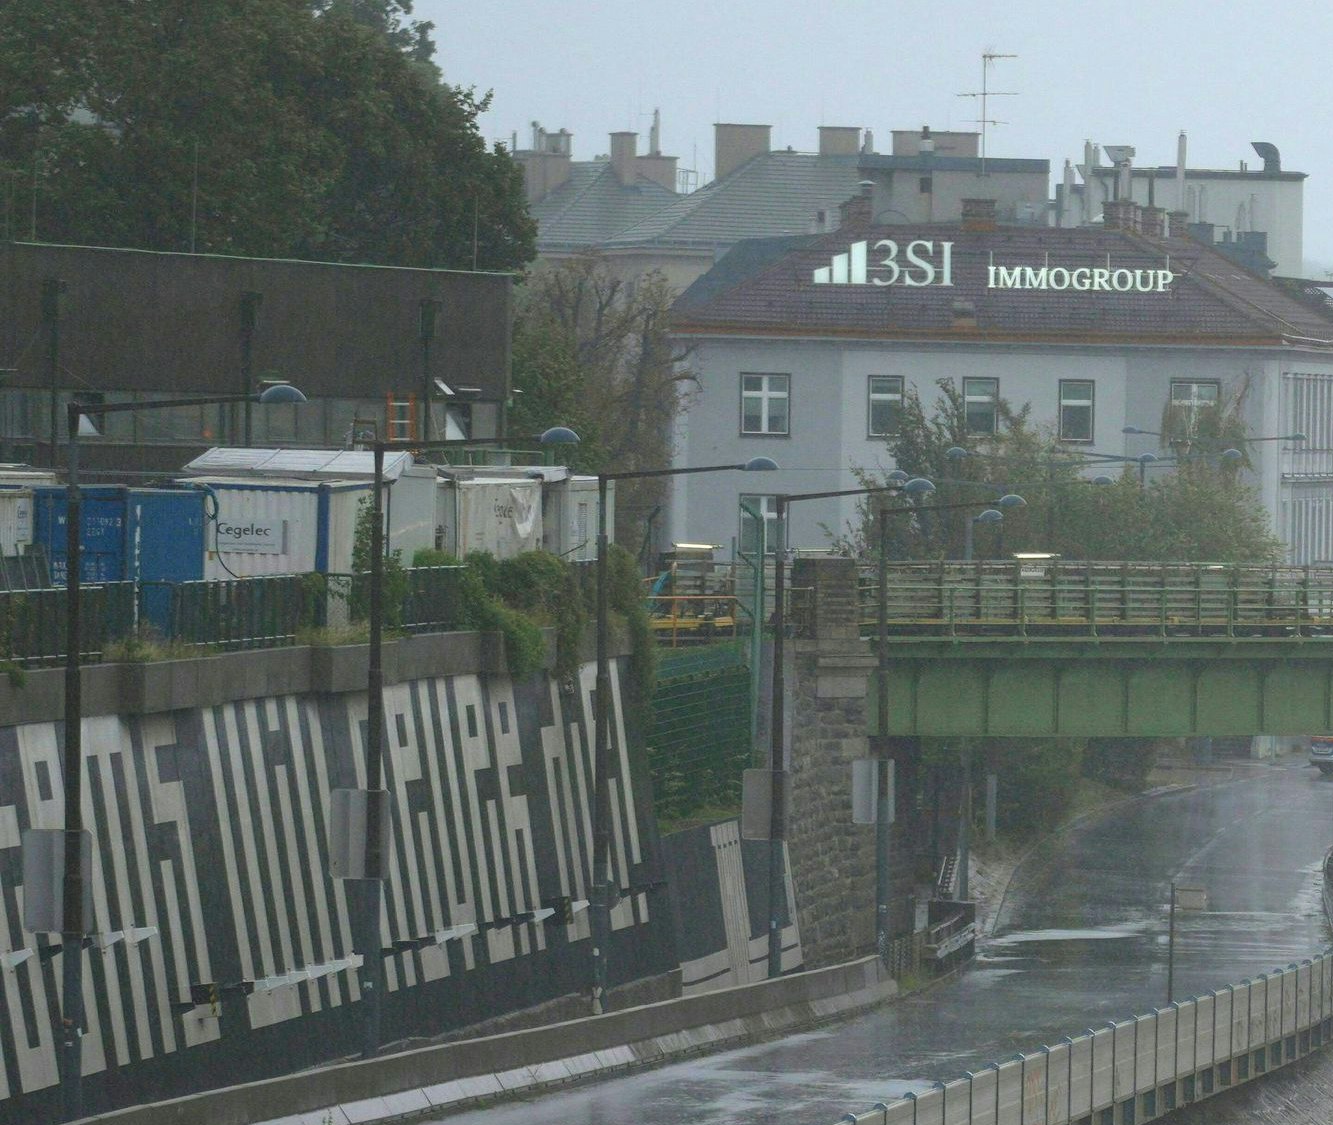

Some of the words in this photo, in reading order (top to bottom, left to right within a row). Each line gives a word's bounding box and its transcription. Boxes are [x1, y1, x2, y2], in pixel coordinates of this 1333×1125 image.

[873, 240, 955, 287] 3SI
[987, 265, 1175, 293] IMMOGROUP
[216, 522, 272, 539] Cegelec
